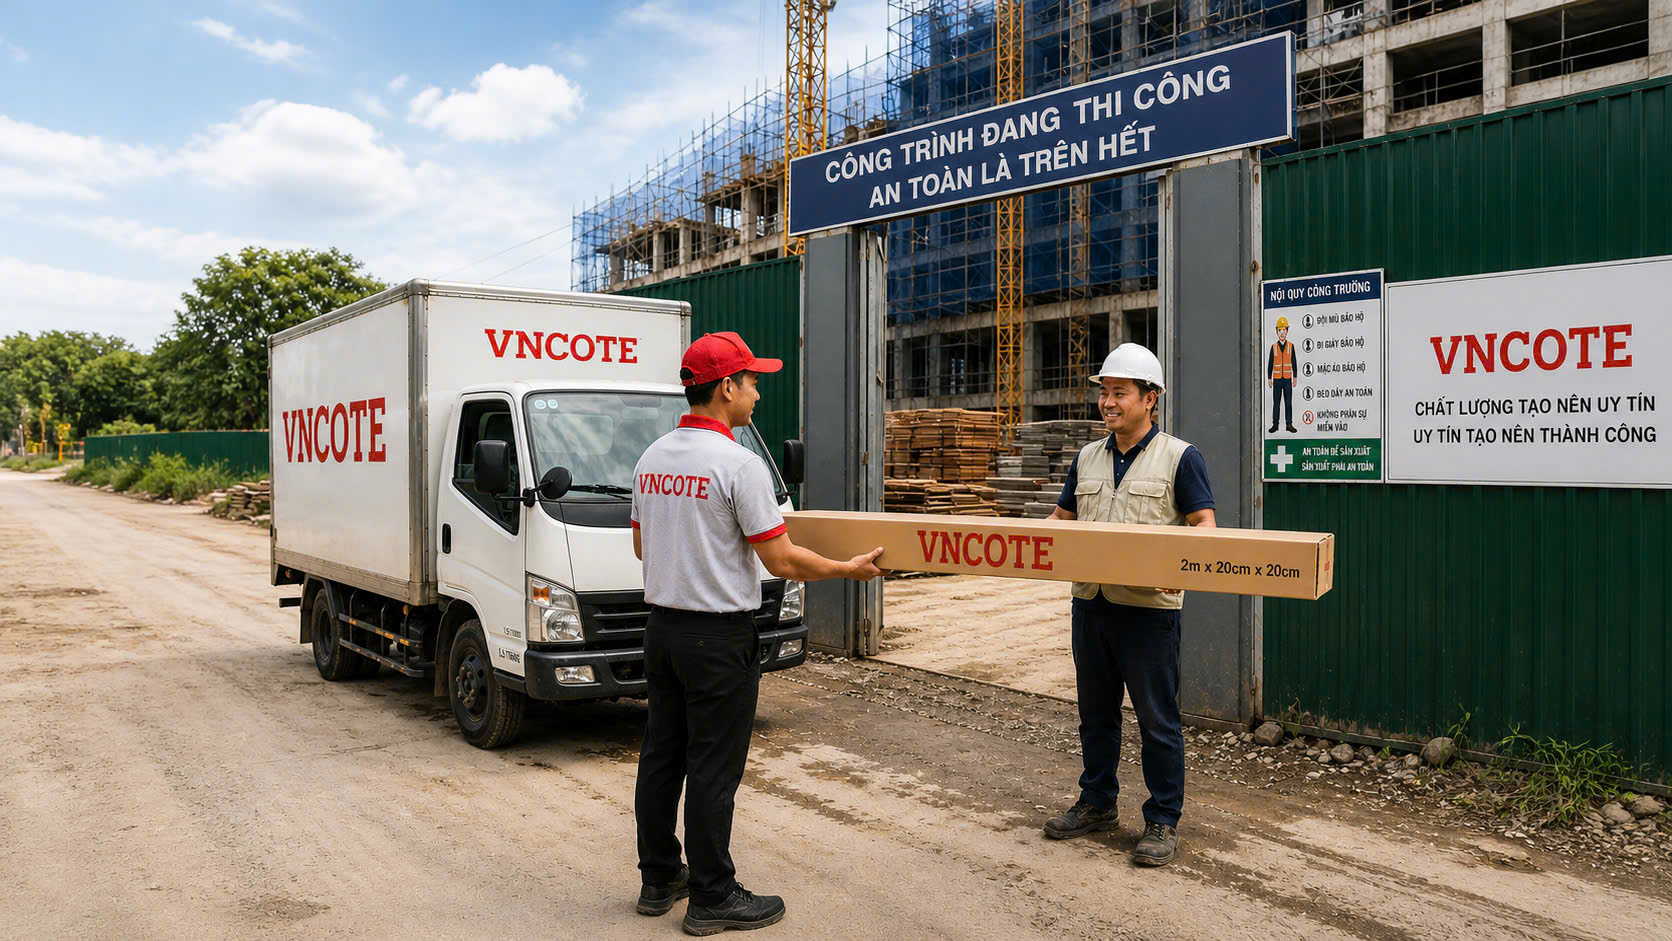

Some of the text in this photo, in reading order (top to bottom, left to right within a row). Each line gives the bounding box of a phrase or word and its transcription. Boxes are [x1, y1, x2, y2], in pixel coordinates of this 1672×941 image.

[826, 64, 1230, 184] CÔNG TRÌNH ĐANG THI CÔNG
[869, 119, 1155, 208] AN TOÀN LÀ TRÊN HẾT
[1288, 288, 1304, 301] QUY
[485, 329, 637, 363] VNCOTE
[1430, 324, 1632, 374] VNCOTE
[1415, 392, 1655, 418] CHẤT LƯỢNG TẠO NÊN UY TÍN
[282, 397, 386, 463] VNCOTE
[1414, 423, 1656, 446] UY TÍN TẠO NÊN THÀNH CÔNG
[639, 473, 710, 500] VNCOTE
[917, 530, 1053, 570] VNCOTE
[1181, 559, 1300, 578] 2m x 20cm x 20cm
